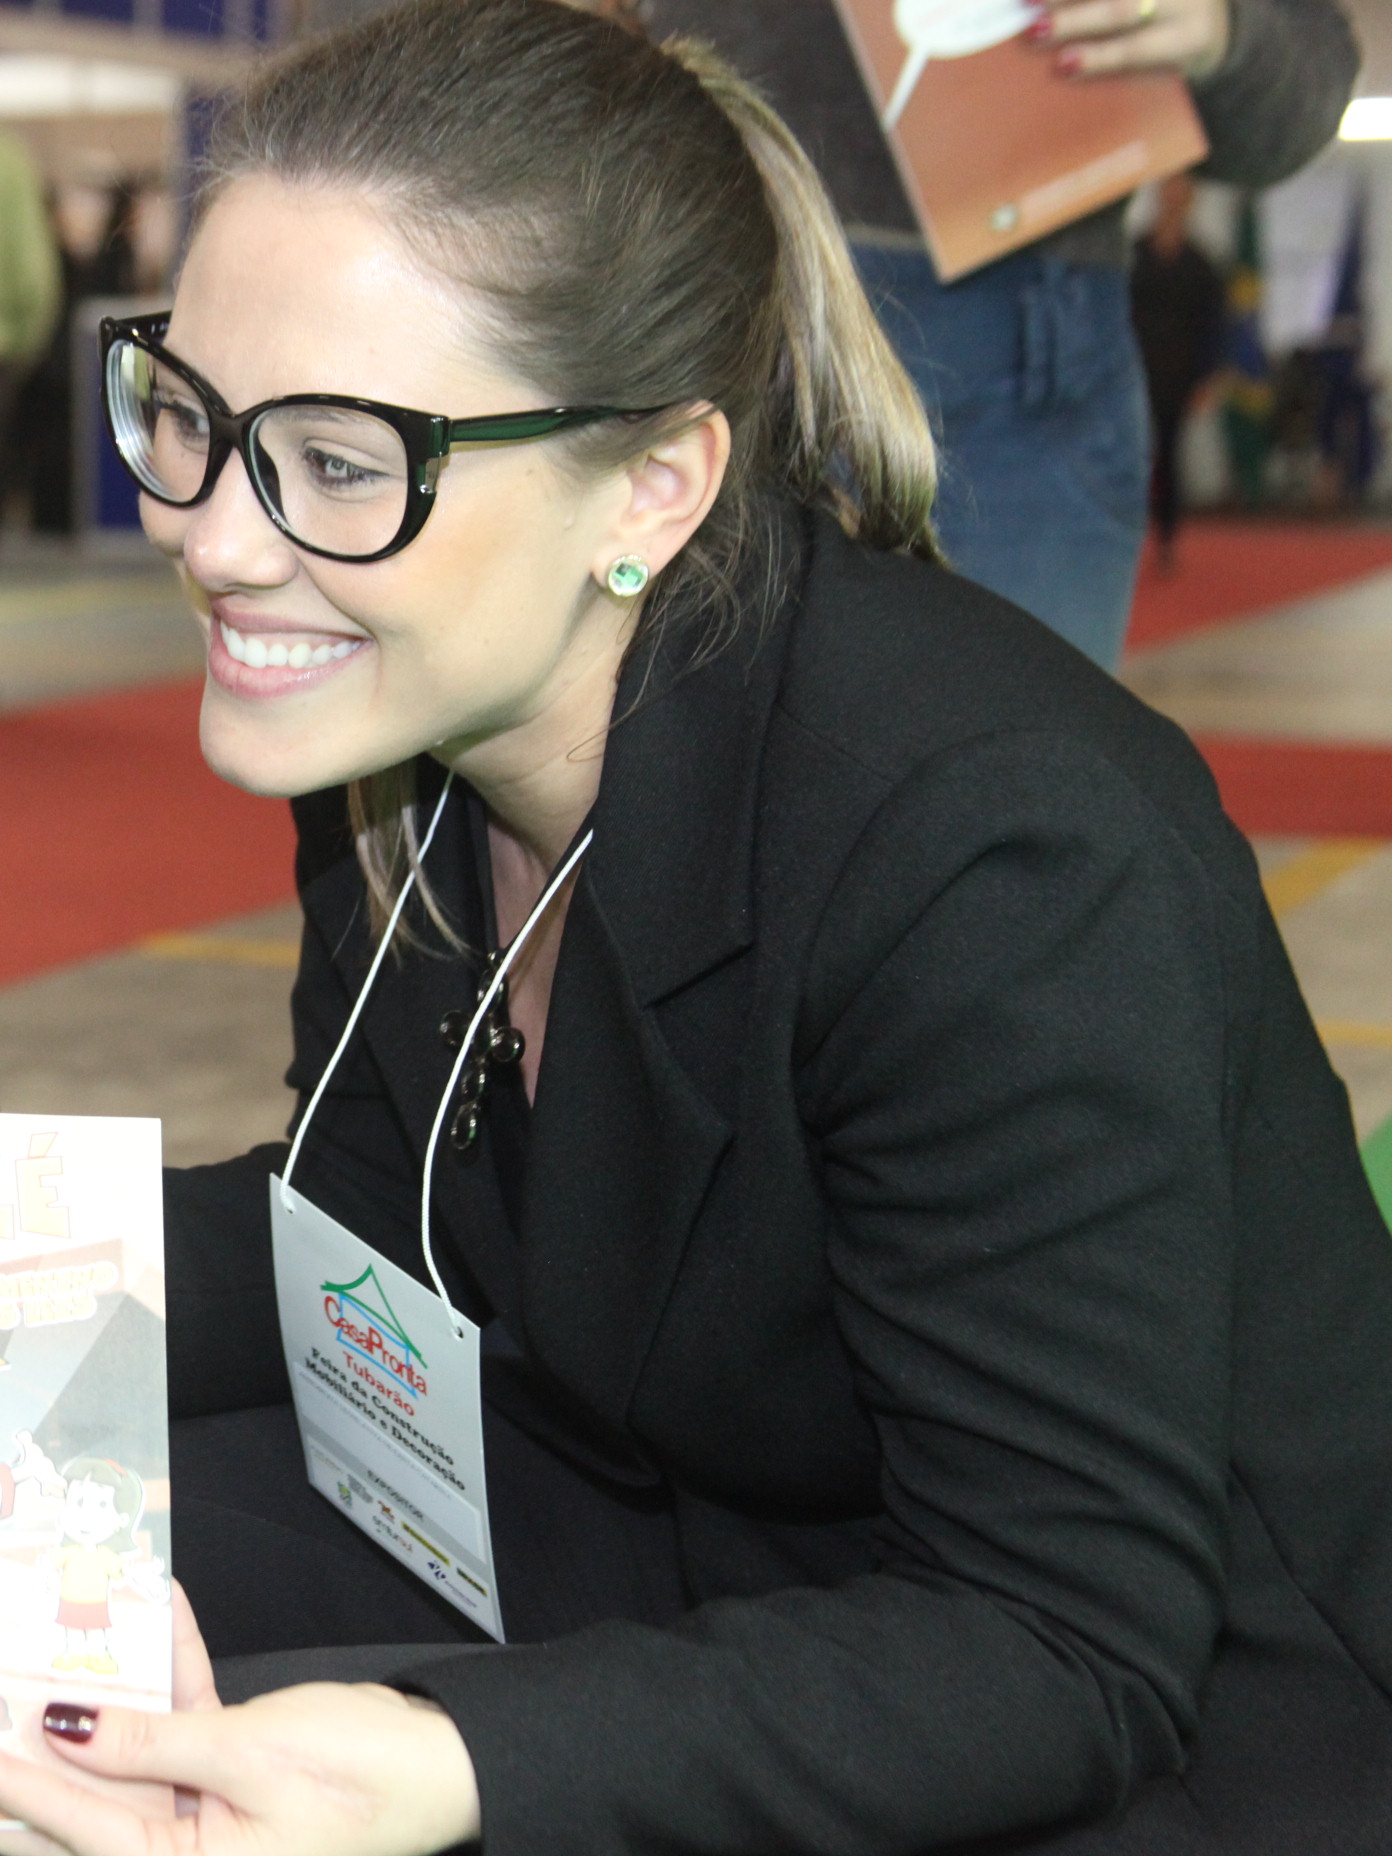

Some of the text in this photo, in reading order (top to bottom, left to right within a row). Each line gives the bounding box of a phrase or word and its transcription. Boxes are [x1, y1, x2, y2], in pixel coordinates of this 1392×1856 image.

[305, 1357, 376, 1420] Mobiliário
[392, 1426, 465, 1490] Decoração
[311, 1347, 347, 1382] Feira
[351, 1380, 368, 1399] da
[372, 1395, 454, 1465] Construção
[343, 1351, 414, 1416] Tubarão
